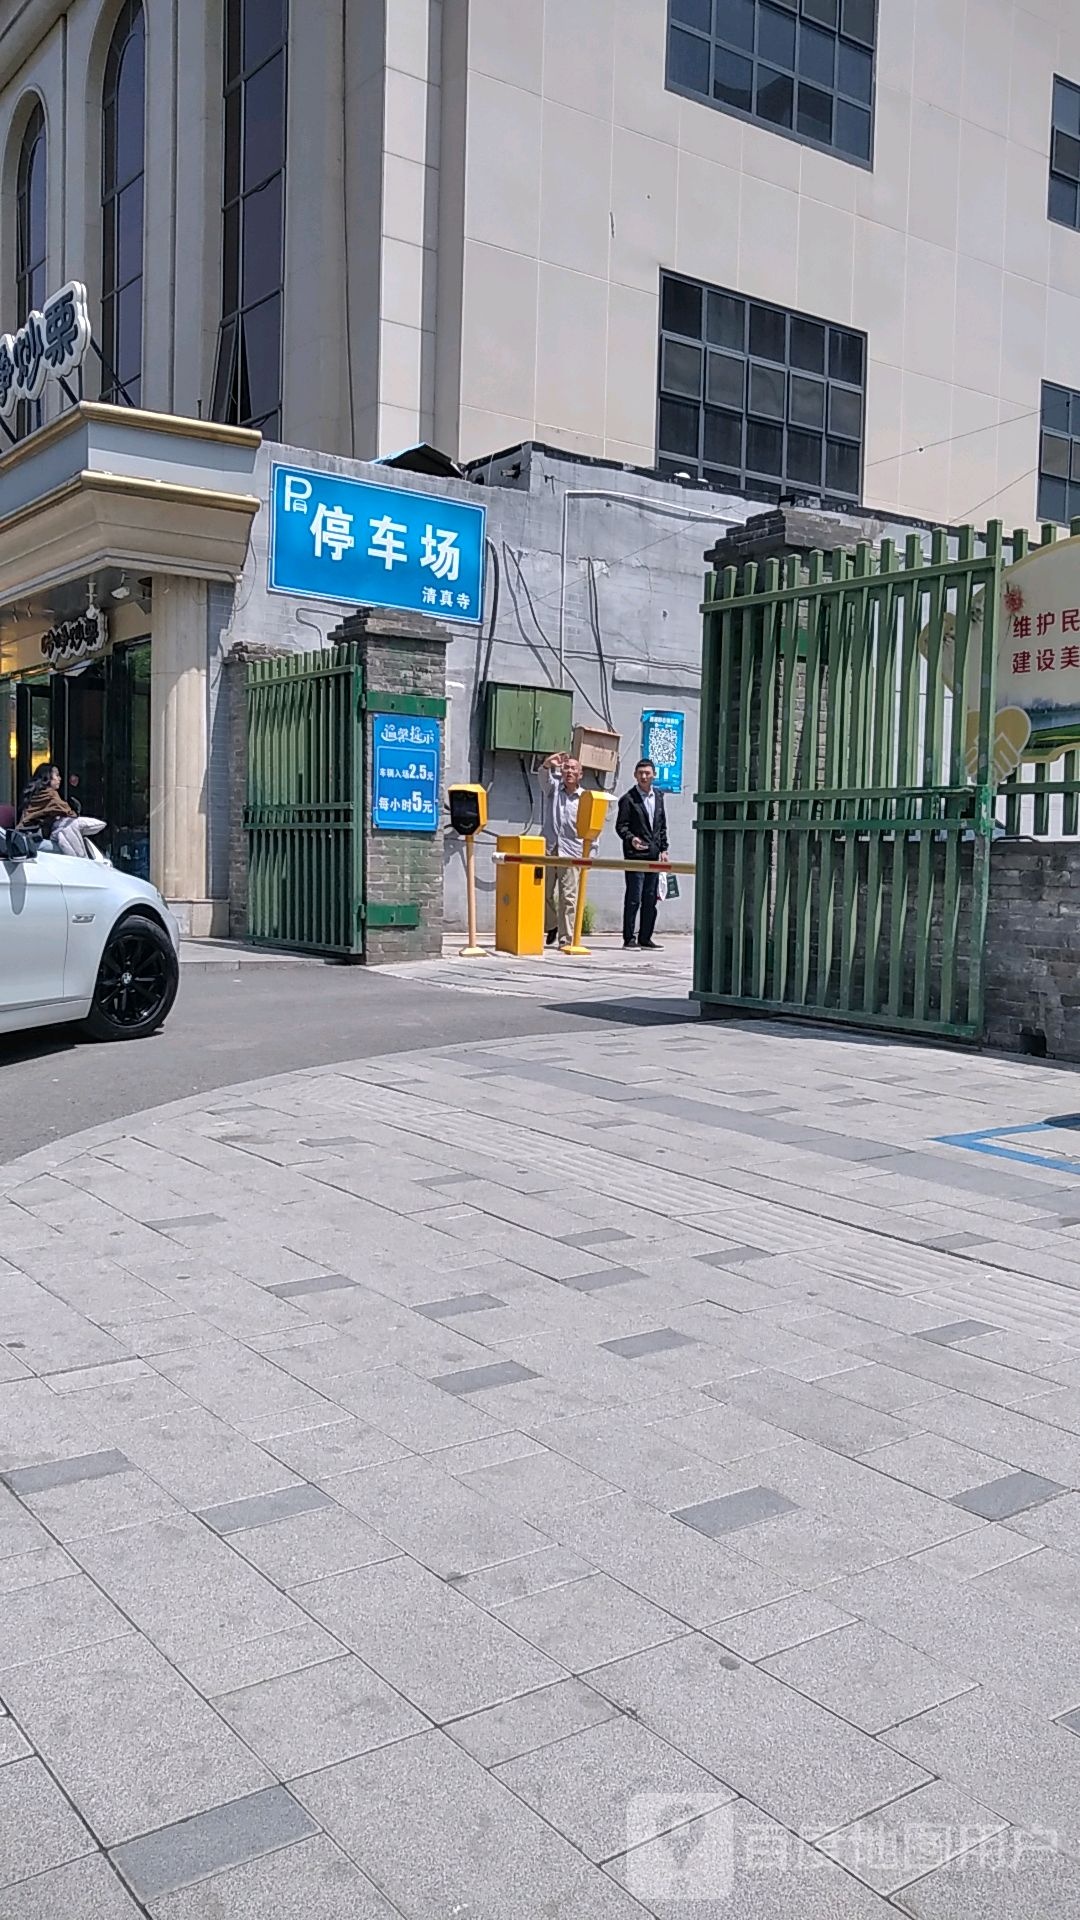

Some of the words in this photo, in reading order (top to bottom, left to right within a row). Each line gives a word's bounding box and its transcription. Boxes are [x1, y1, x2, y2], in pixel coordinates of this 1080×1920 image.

[309, 501, 460, 582] 停车场
[421, 585, 471, 611] 清真寺
[1012, 608, 1080, 639] 维护民
[1012, 645, 1080, 674] 建设美
[381, 723, 434, 745] 温馨提示
[379, 763, 434, 781] 车辆入场2.5元
[378, 790, 433, 814] 每小时5元
